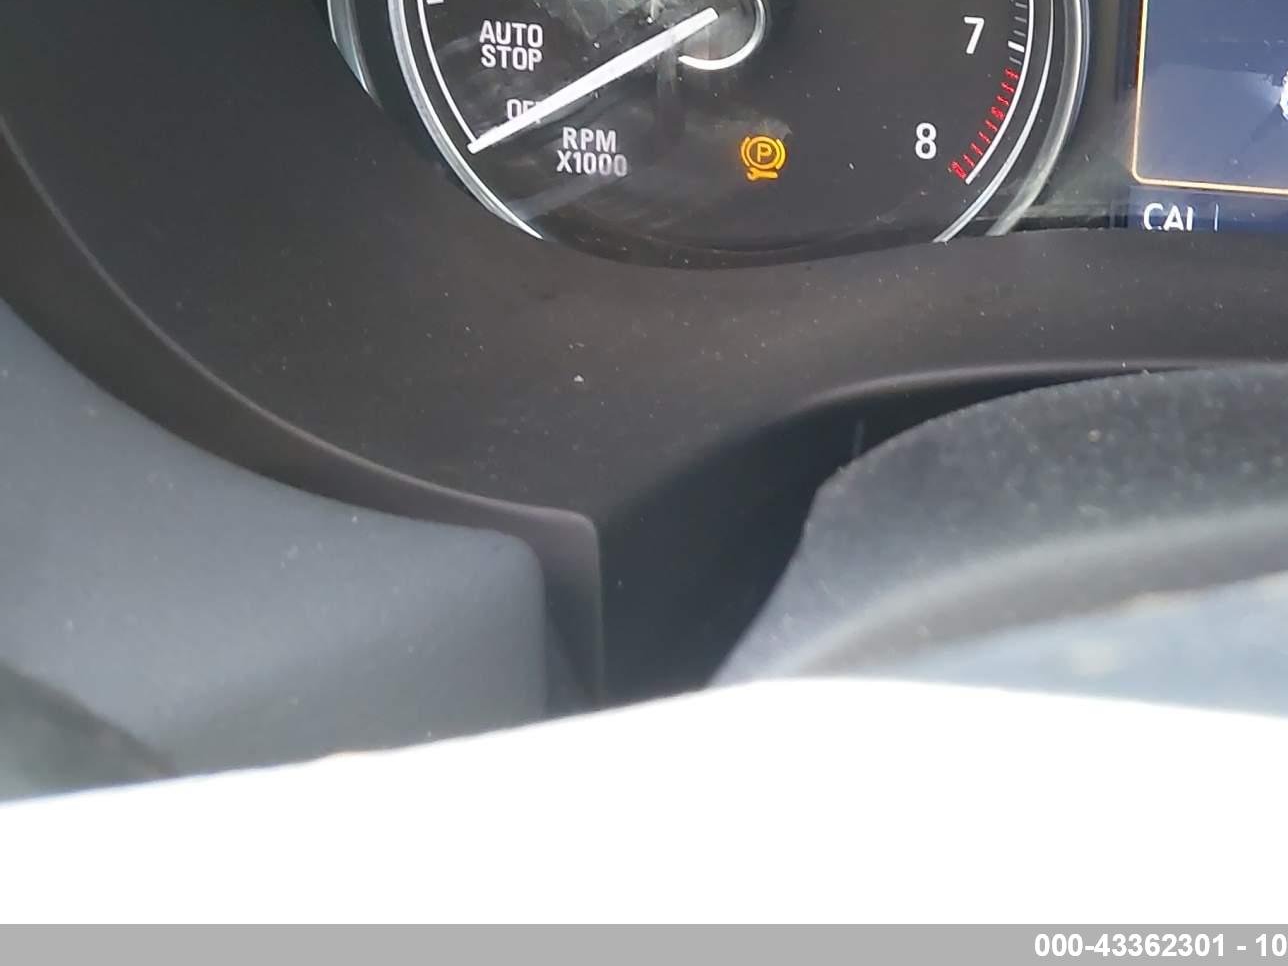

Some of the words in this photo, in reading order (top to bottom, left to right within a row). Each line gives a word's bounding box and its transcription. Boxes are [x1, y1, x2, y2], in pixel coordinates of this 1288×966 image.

[479, 20, 543, 48] AUTO
[963, 16, 985, 55] 7
[480, 44, 543, 71] STOP
[562, 126, 617, 153] RPM
[914, 122, 937, 160] 8
[556, 150, 628, 177] X1000
